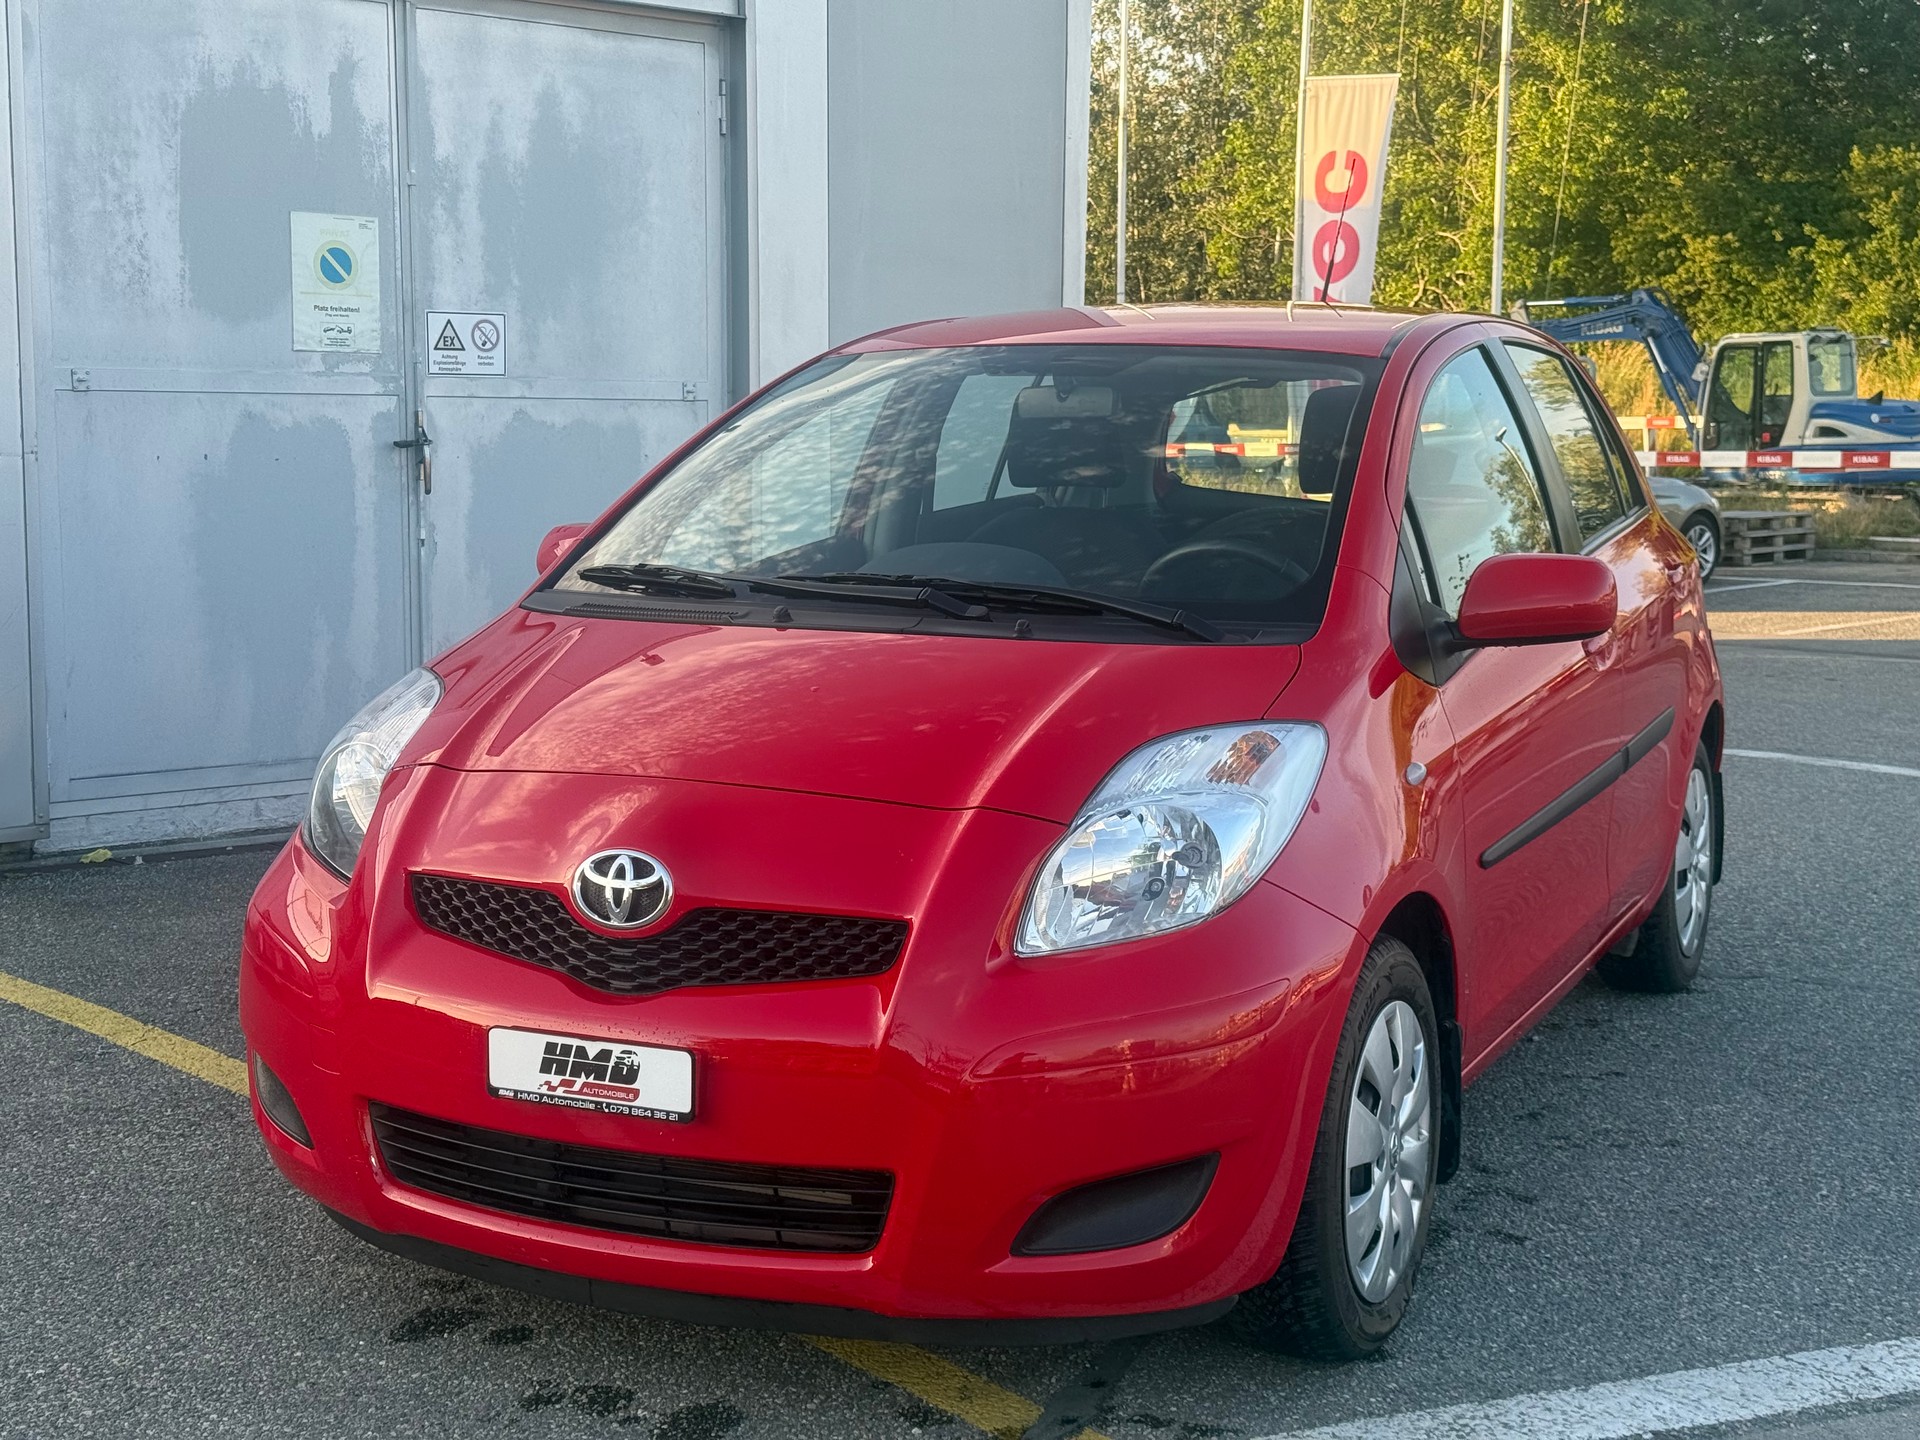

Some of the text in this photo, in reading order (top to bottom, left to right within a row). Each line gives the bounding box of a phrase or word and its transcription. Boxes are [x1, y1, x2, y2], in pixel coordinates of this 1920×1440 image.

[313, 304, 360, 314] Platz freihalten!
[443, 335, 456, 347] EX
[1756, 455, 1783, 463] KIBAG
[1852, 455, 1879, 464] KIBAG
[539, 1041, 640, 1086] HMD
[582, 1086, 635, 1100] AUTOMOBILE
[517, 1093, 540, 1102] HMD
[541, 1096, 596, 1110] Automobile
[609, 1104, 630, 1115] 079
[631, 1107, 652, 1118] 864
[653, 1110, 667, 1120] 36
[668, 1112, 679, 1122] 21
